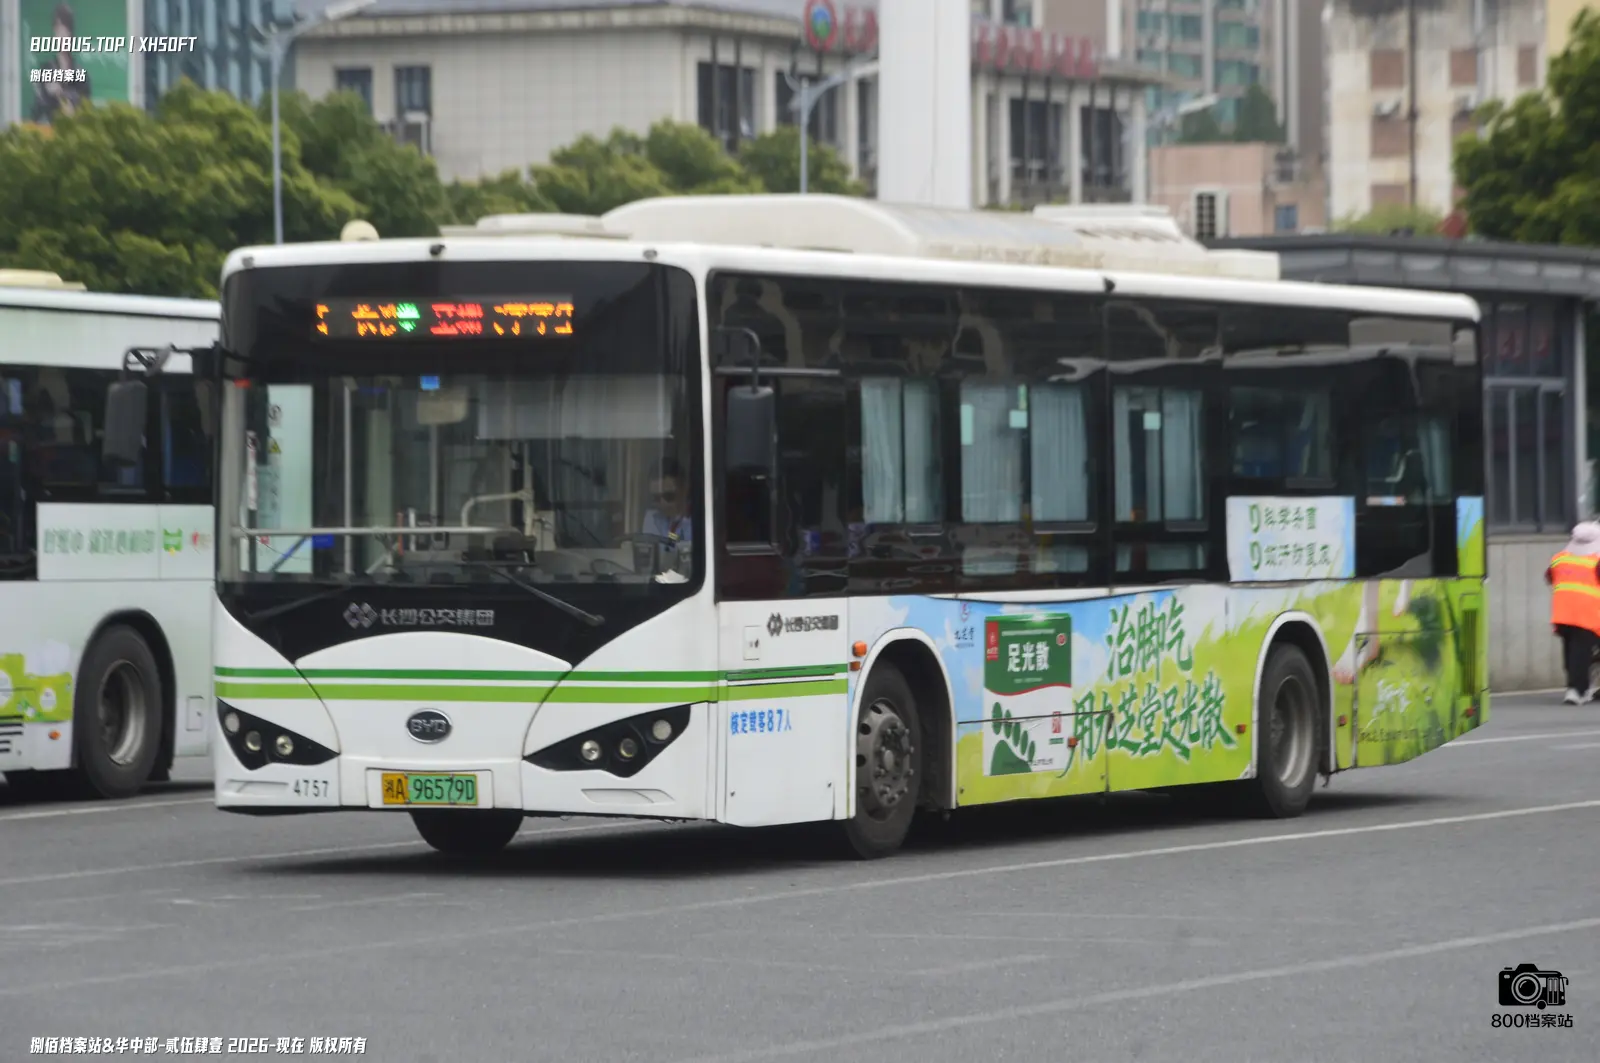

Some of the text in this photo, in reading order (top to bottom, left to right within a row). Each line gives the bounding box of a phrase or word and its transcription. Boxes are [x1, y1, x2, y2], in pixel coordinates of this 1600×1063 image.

[380, 608, 495, 626] 长沙公交集团
[1106, 595, 1193, 682] 治脚气
[1007, 641, 1050, 673] 足光散
[410, 718, 447, 733] BYD
[1066, 671, 1237, 767] 用九芝堂足光散
[293, 780, 329, 798] 4757
